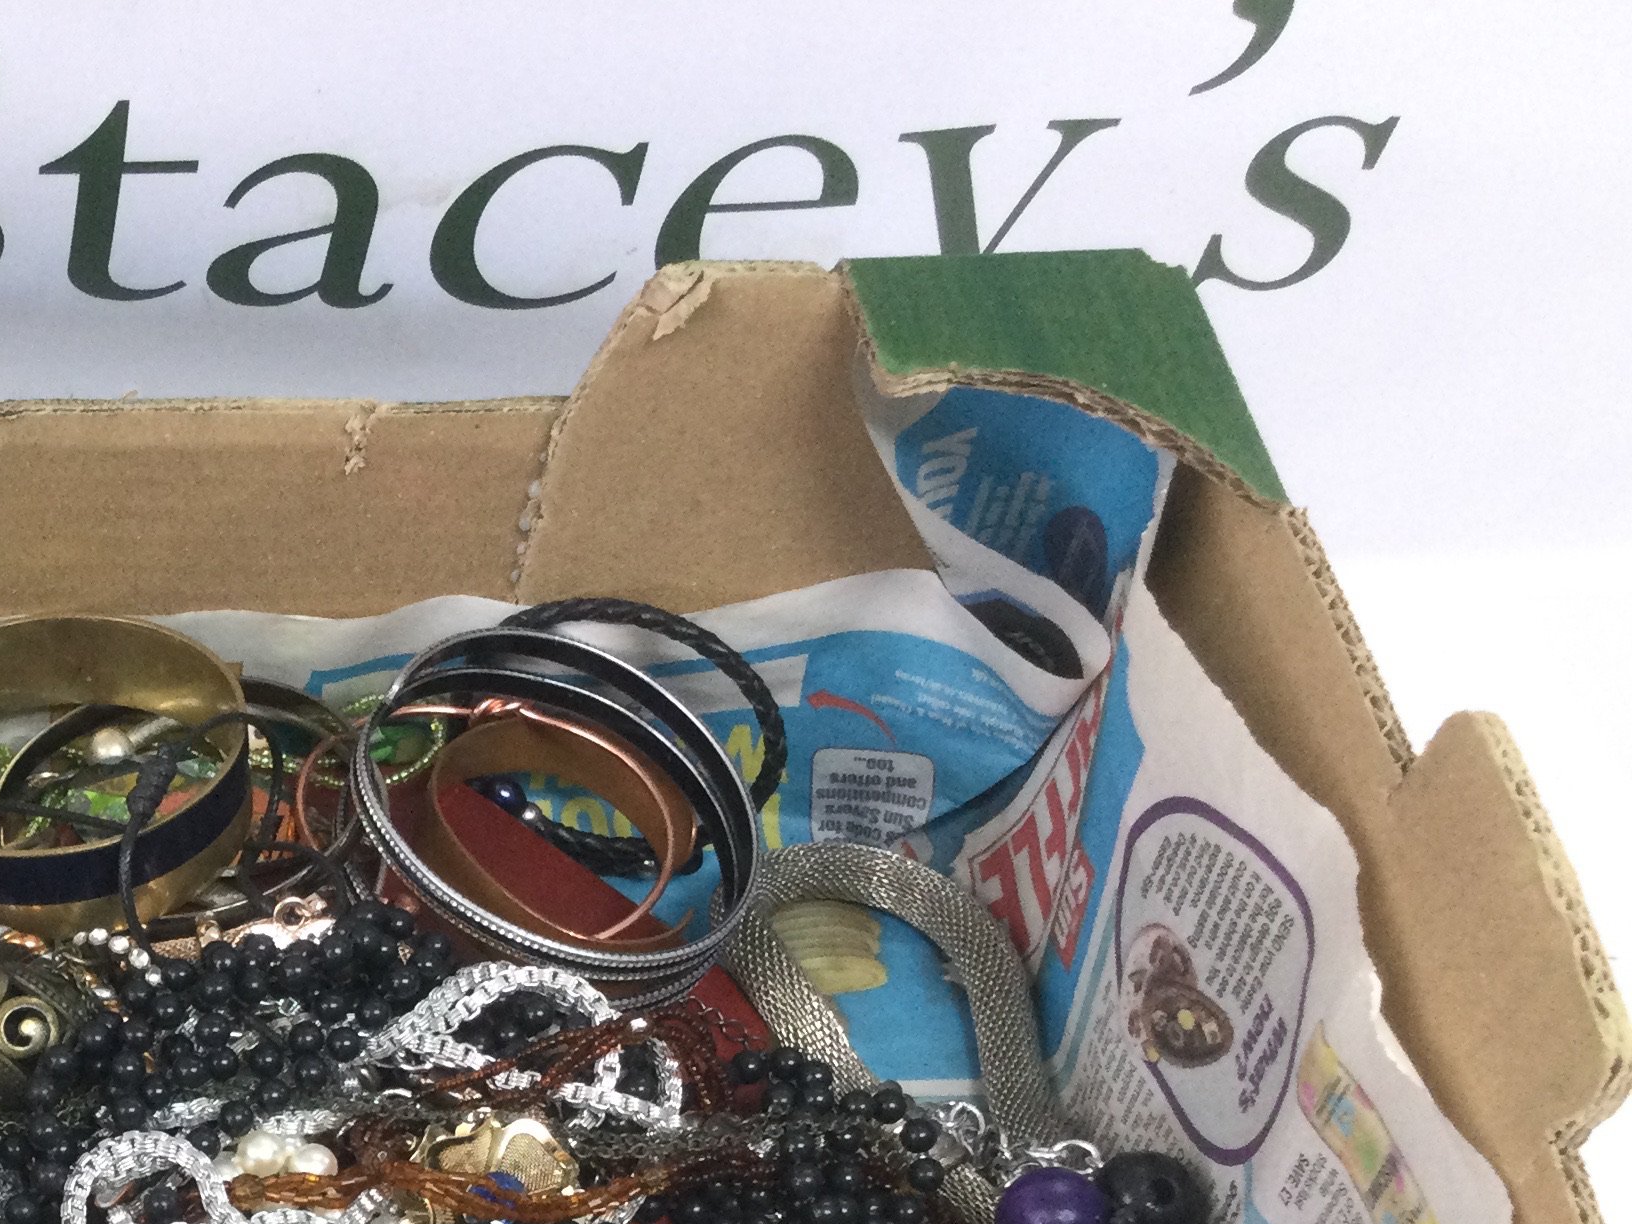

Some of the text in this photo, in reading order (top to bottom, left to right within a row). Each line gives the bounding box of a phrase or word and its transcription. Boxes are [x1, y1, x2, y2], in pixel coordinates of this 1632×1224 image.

[829, 772, 918, 790] and offers
[824, 804, 915, 830] Sun Savers
[1203, 850, 1237, 912] chocolate
